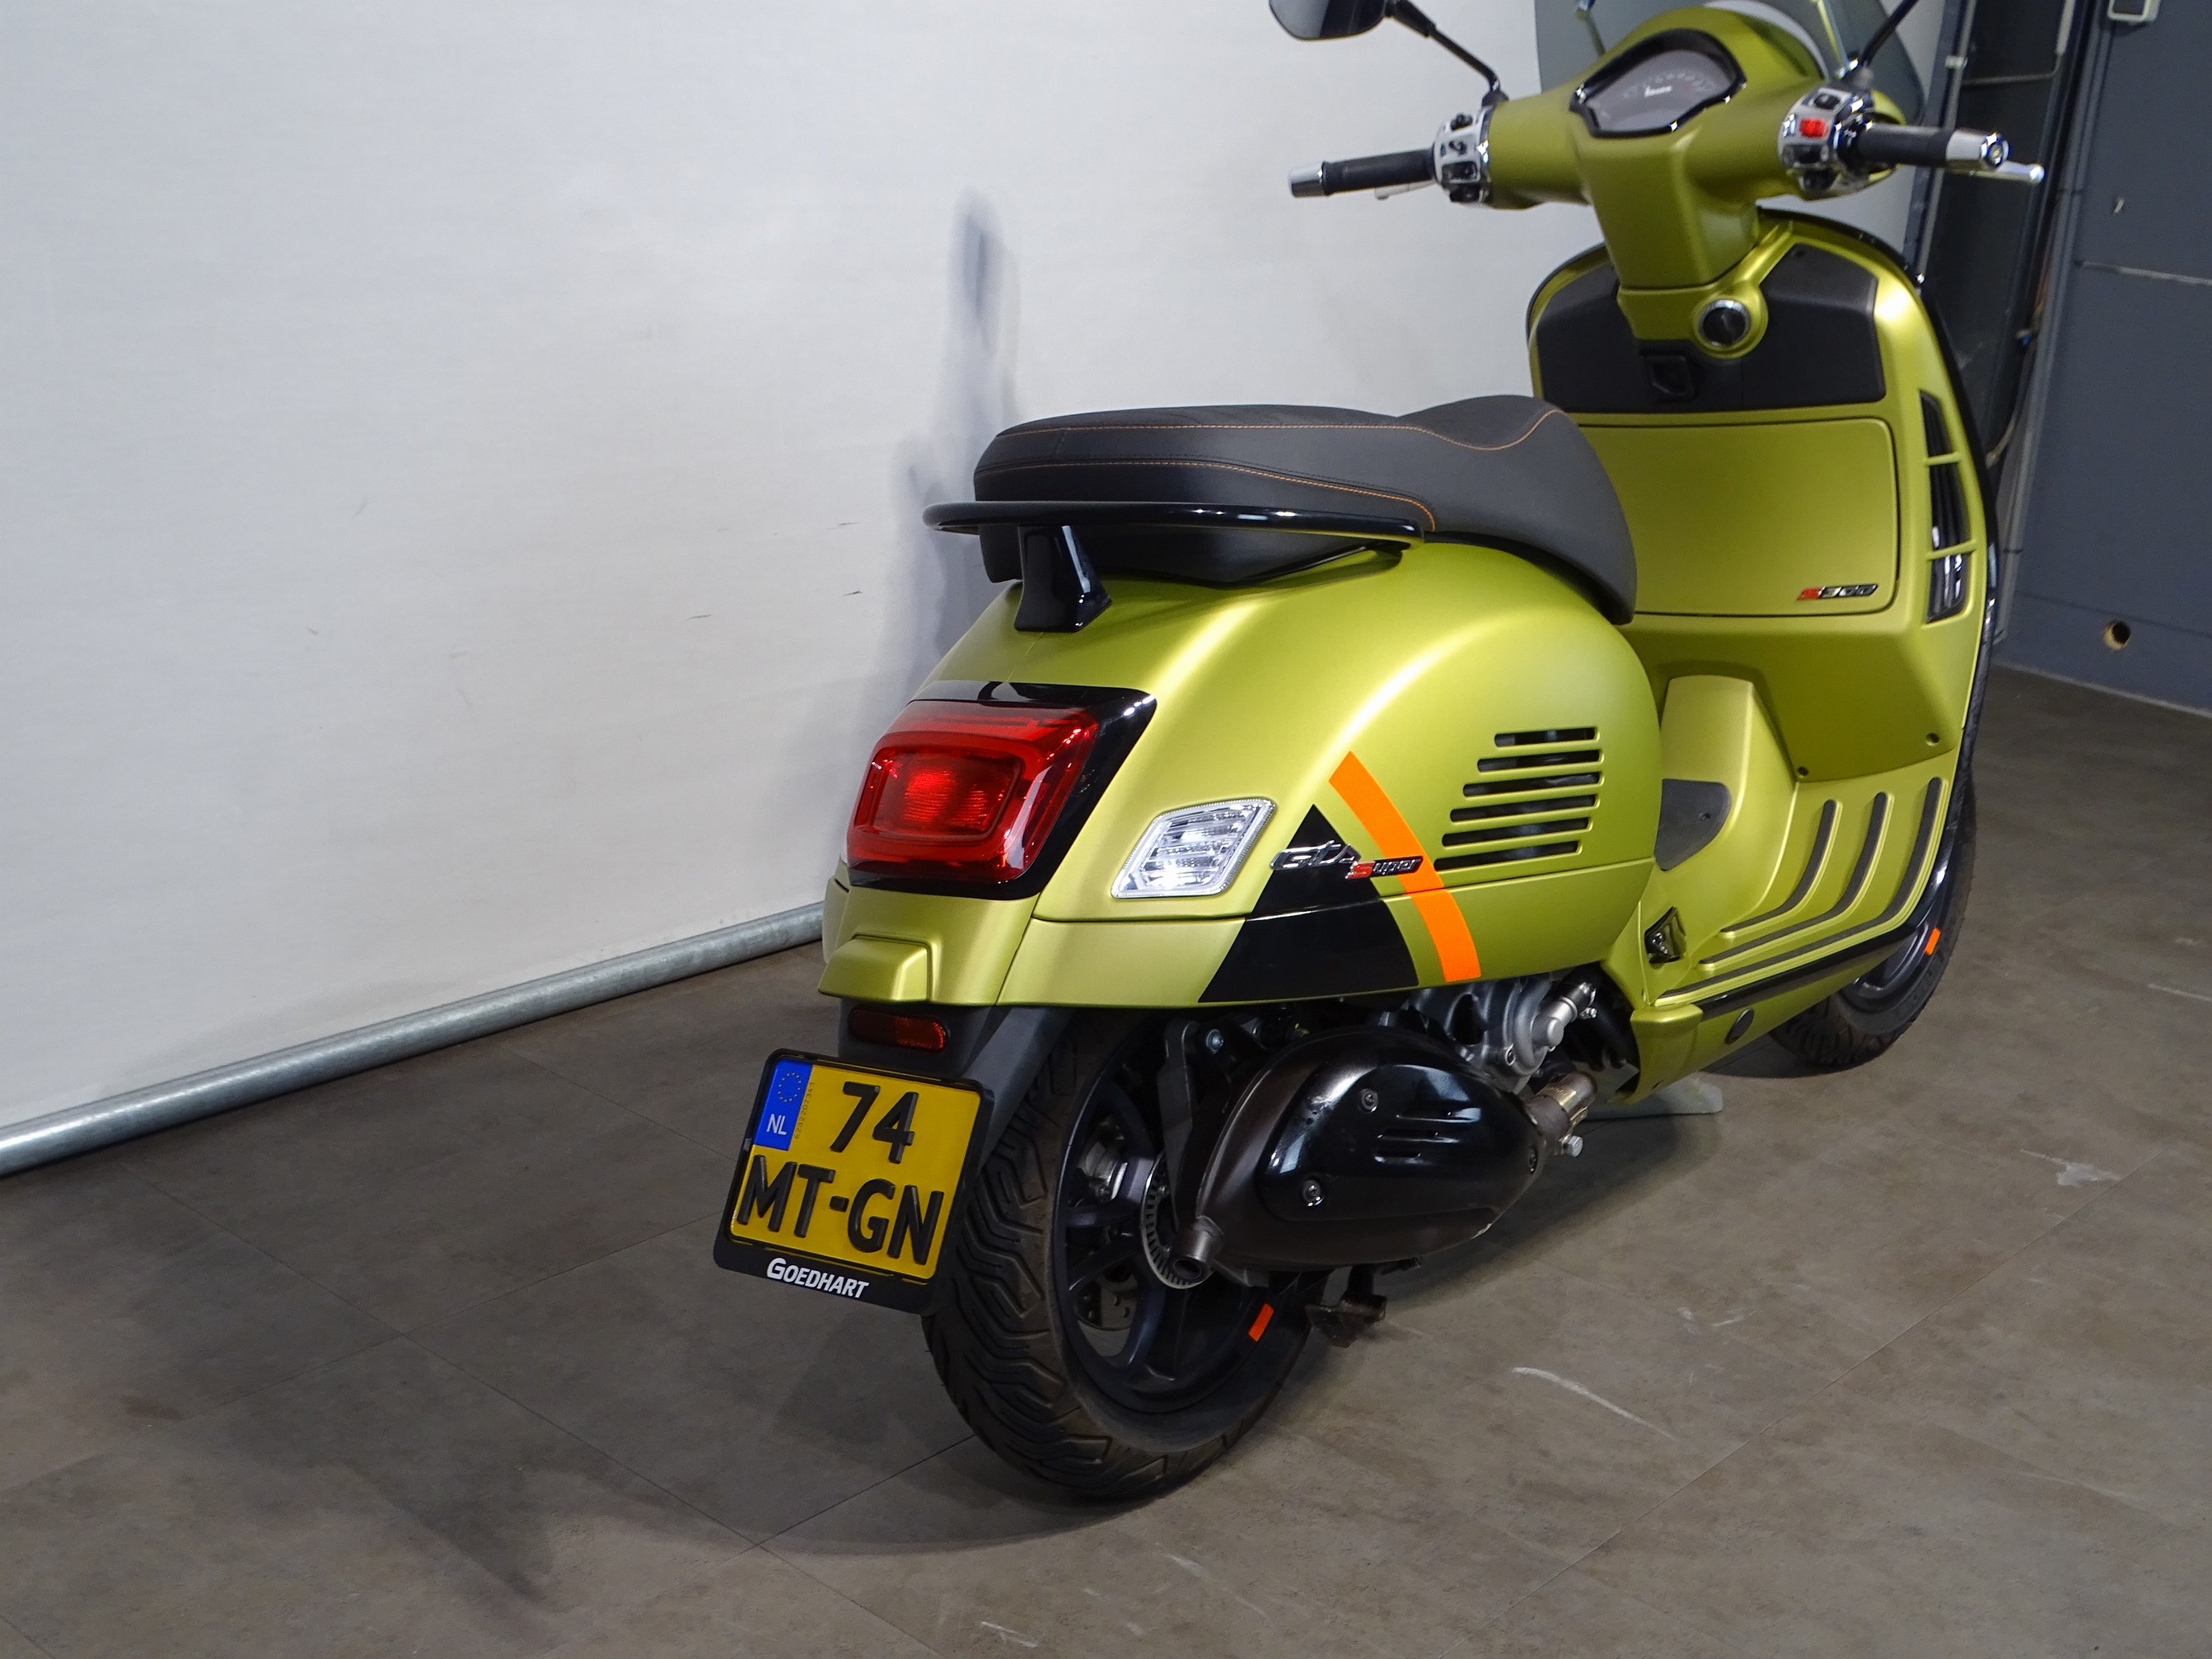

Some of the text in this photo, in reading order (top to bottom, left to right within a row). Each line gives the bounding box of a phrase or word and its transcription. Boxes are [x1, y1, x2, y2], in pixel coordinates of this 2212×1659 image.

[766, 1114, 788, 1135] NL
[830, 1081, 919, 1164] 74
[737, 1155, 944, 1265] MT-GN
[766, 1257, 870, 1299] GOEDHART
